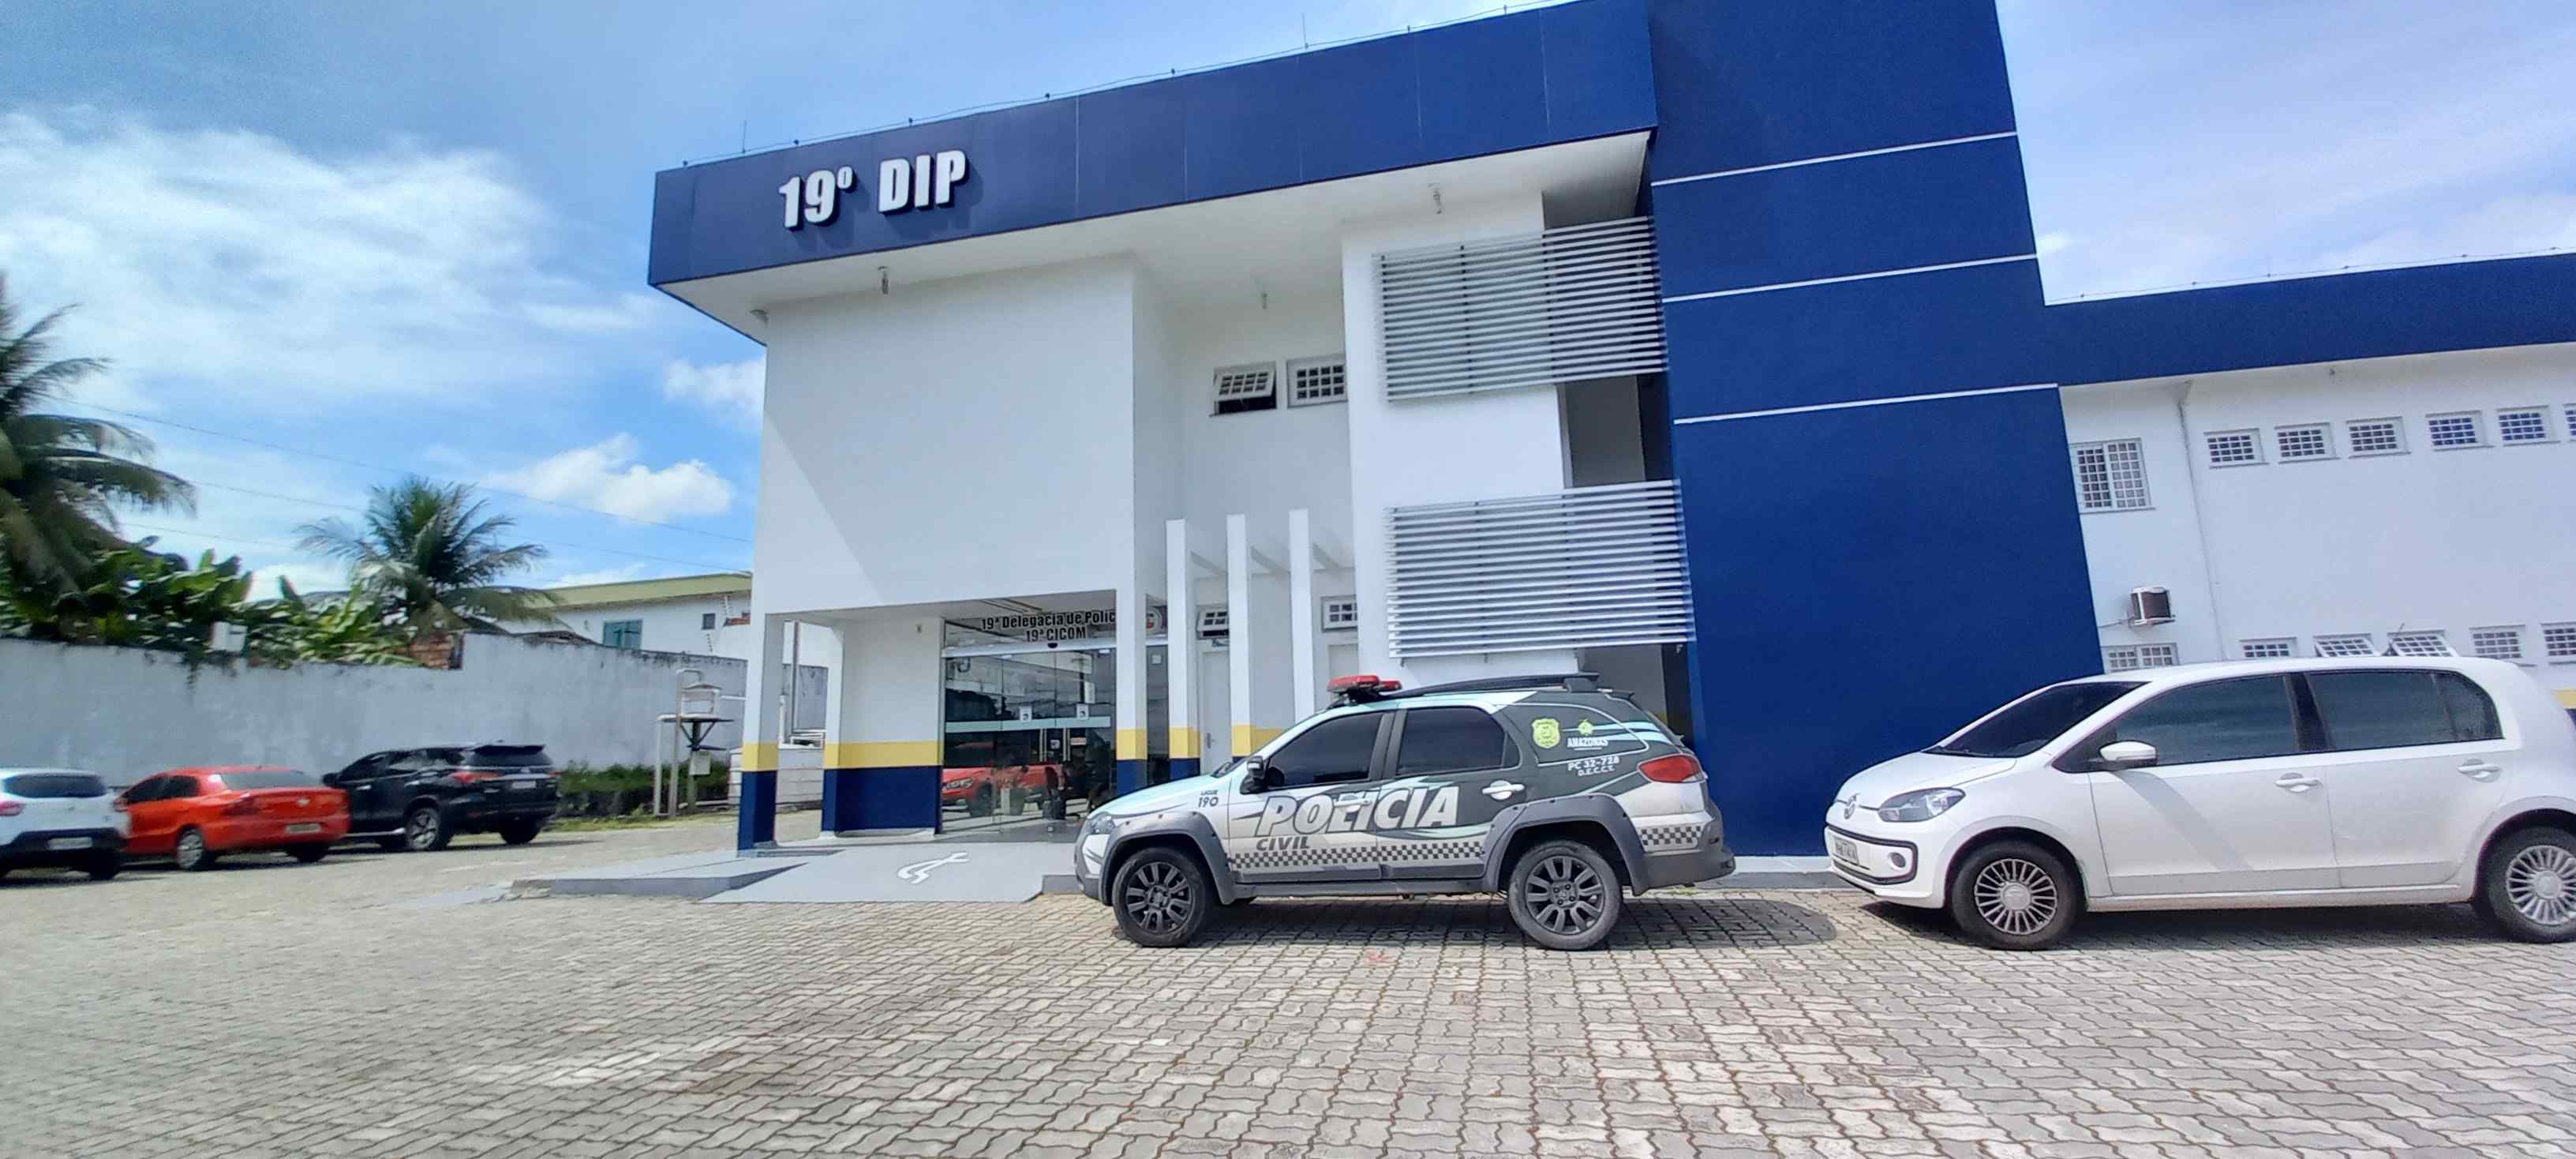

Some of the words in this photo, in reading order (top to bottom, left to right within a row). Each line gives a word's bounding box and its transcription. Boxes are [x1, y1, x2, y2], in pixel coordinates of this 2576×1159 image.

[878, 150, 967, 213] DIP
[1002, 613, 1063, 628] Delegacia
[1067, 612, 1081, 625] de
[1046, 627, 1086, 640] CICOM
[1567, 737, 1608, 748] AMAZONAS
[1567, 762, 1582, 771] PC
[1198, 797, 1219, 808] 190
[1256, 836, 1310, 851] CIVIL
